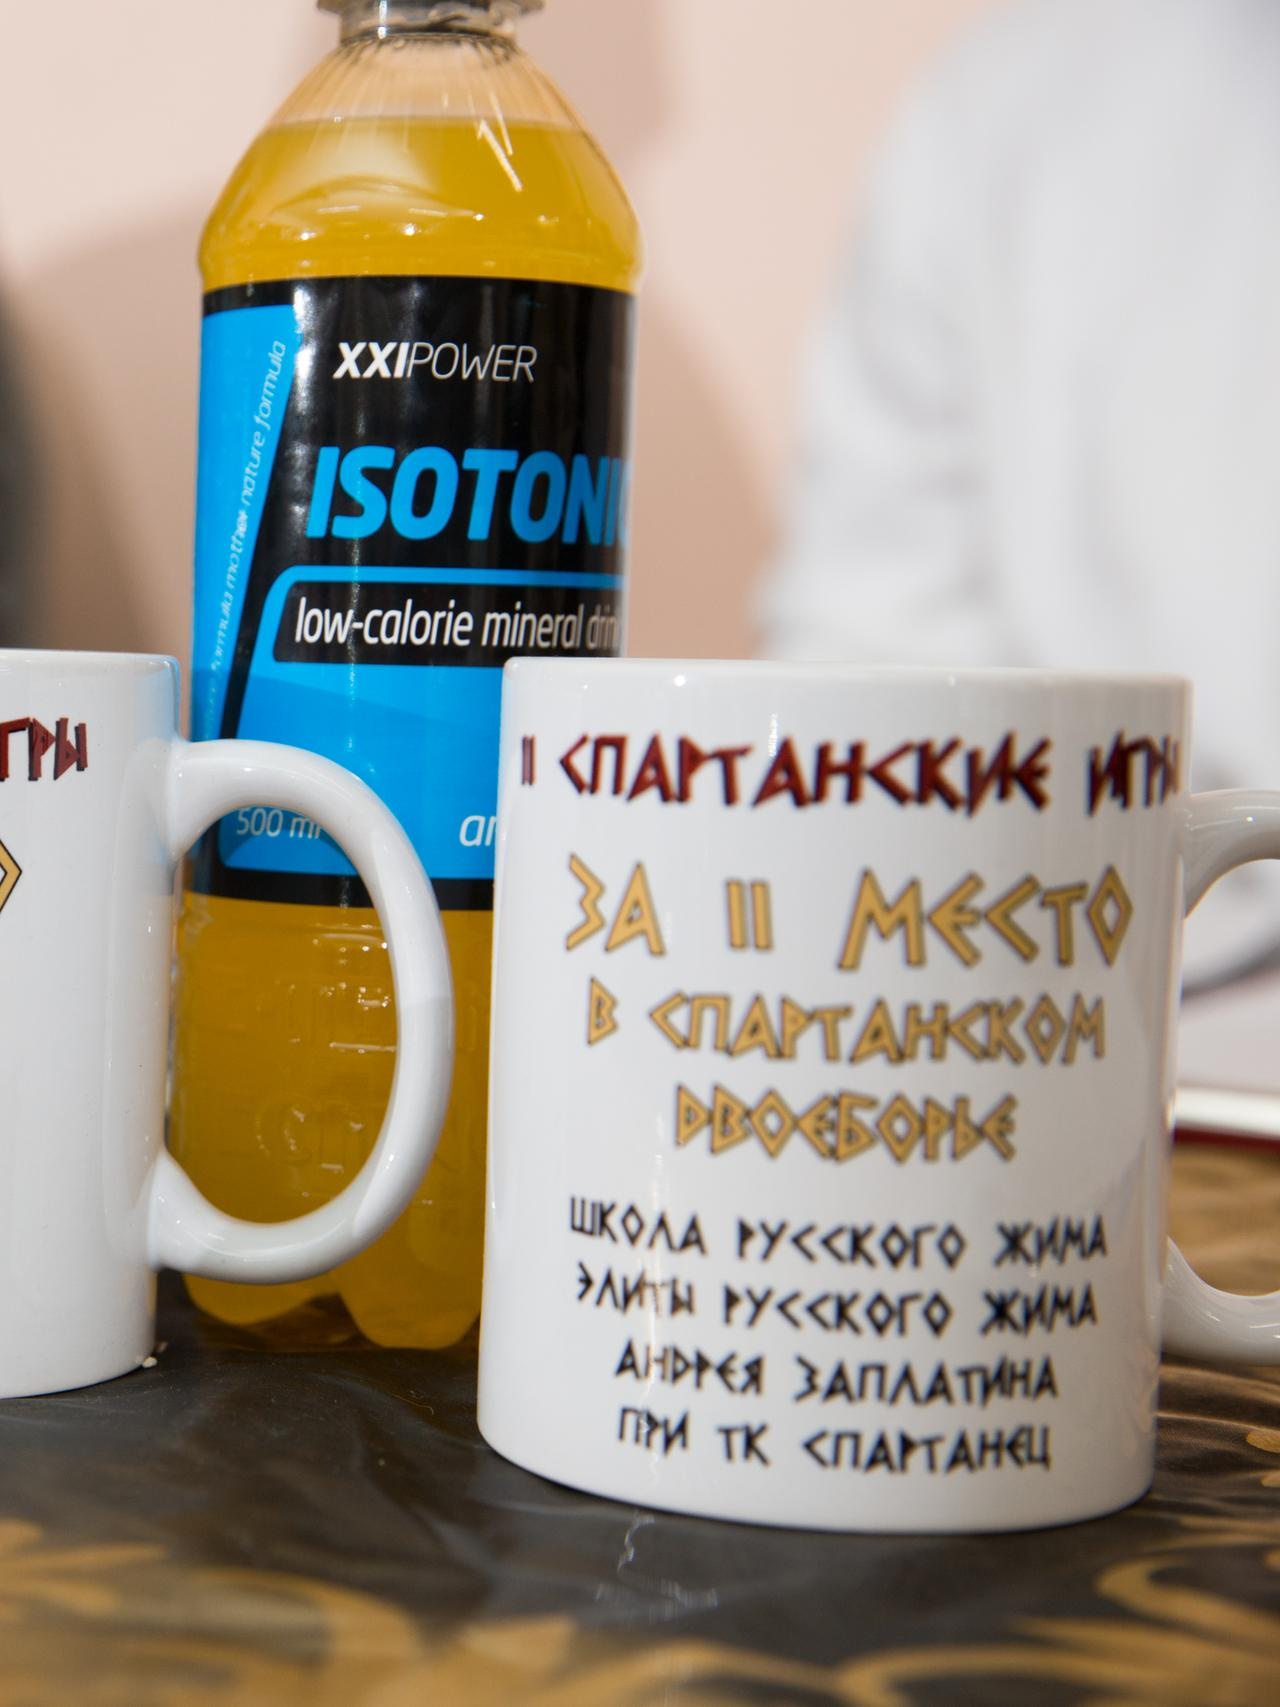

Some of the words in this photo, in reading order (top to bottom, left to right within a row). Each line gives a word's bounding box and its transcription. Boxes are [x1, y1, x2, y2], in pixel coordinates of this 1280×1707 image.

[332, 341, 538, 383] XXIPOWER
[226, 509, 248, 590] mother
[241, 432, 265, 506] nature
[254, 340, 286, 430] formula
[306, 446, 628, 546] ISOTONI
[295, 596, 473, 648] low-calorie
[481, 601, 585, 649] mineral
[586, 604, 620, 650] drin
[558, 729, 1053, 820] СПАРТАНСКИЕ
[236, 808, 284, 835] 500
[566, 852, 667, 958] ЗА
[725, 878, 774, 952] II
[837, 865, 1135, 971] МЕСТО
[586, 974, 620, 1047] В
[648, 991, 1107, 1067] СПАРТАНСКОМ
[674, 1083, 1018, 1166] ДВОЕБОРЬЕ
[569, 1195, 709, 1258] ШКОЛА
[735, 1216, 968, 1270] РУССКОГО
[992, 1212, 1110, 1269] ЖИМА
[576, 1260, 696, 1318] ЭЛИТЫ
[723, 1284, 953, 1338] РУССКОГО
[979, 1280, 1099, 1338] ЖИМА
[614, 1337, 767, 1397] АНДРЕЯ
[794, 1355, 1060, 1411] ЗАПЛАТИНА
[617, 1404, 691, 1462] ПРИ
[715, 1424, 770, 1467] ТК
[803, 1422, 1052, 1476] СПАРТАНЕЦ
